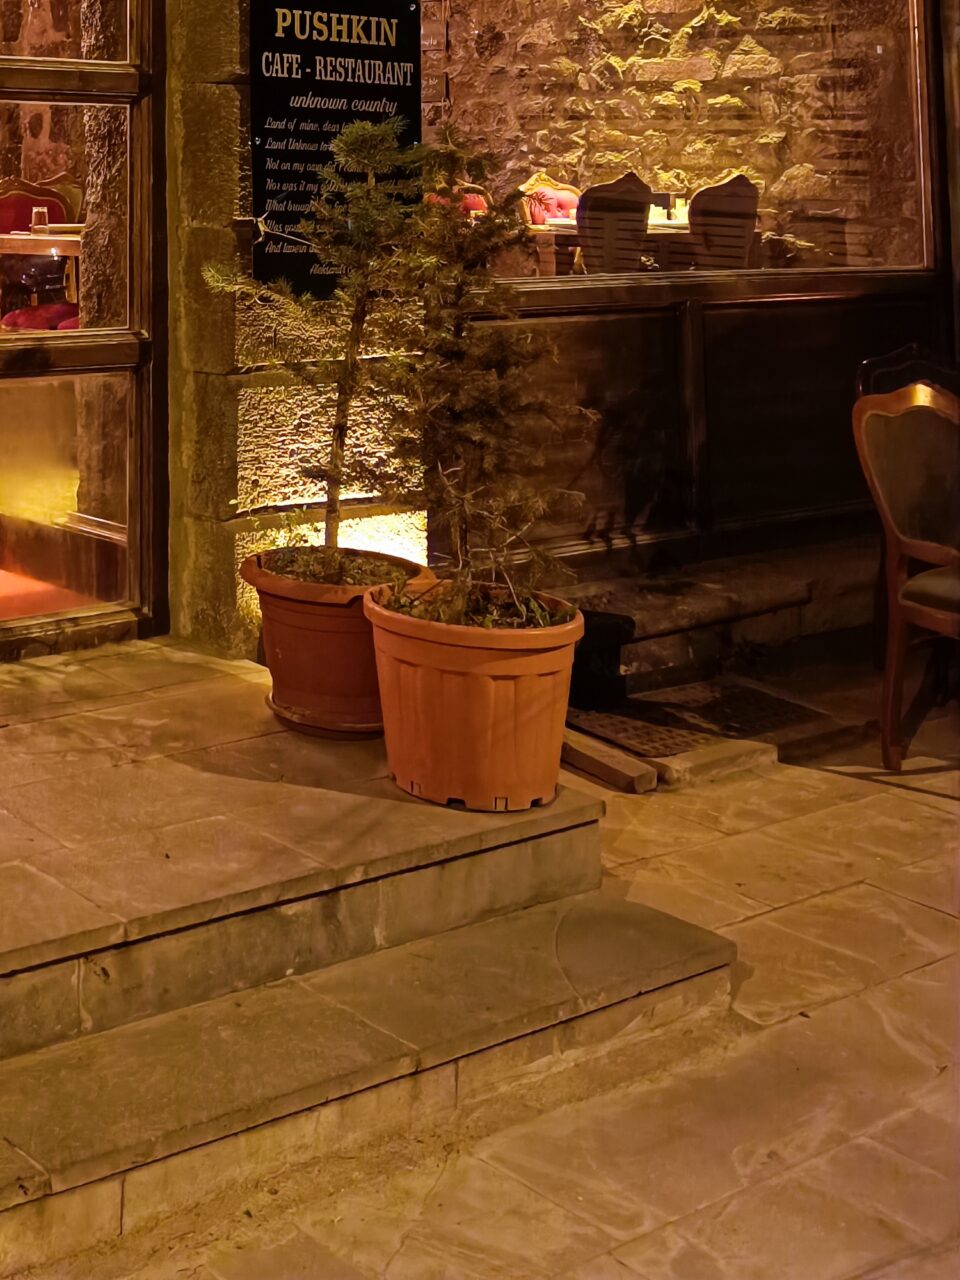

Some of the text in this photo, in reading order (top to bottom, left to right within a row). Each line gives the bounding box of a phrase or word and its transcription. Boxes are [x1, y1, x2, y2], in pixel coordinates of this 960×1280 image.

[274, 8, 399, 47] PUSHKIN
[261, 51, 302, 79] CAFE
[315, 56, 414, 87] RESTAURANT
[289, 91, 398, 116] unknown country
[264, 117, 285, 128] Land
[287, 118, 297, 132] of
[265, 137, 286, 150] Land
[265, 157, 280, 170] Not
[291, 162, 304, 173] my
[265, 177, 280, 190] Nor
[281, 182, 297, 191] was
[306, 182, 319, 193] my
[265, 199, 286, 211] What
[264, 240, 282, 253] And
